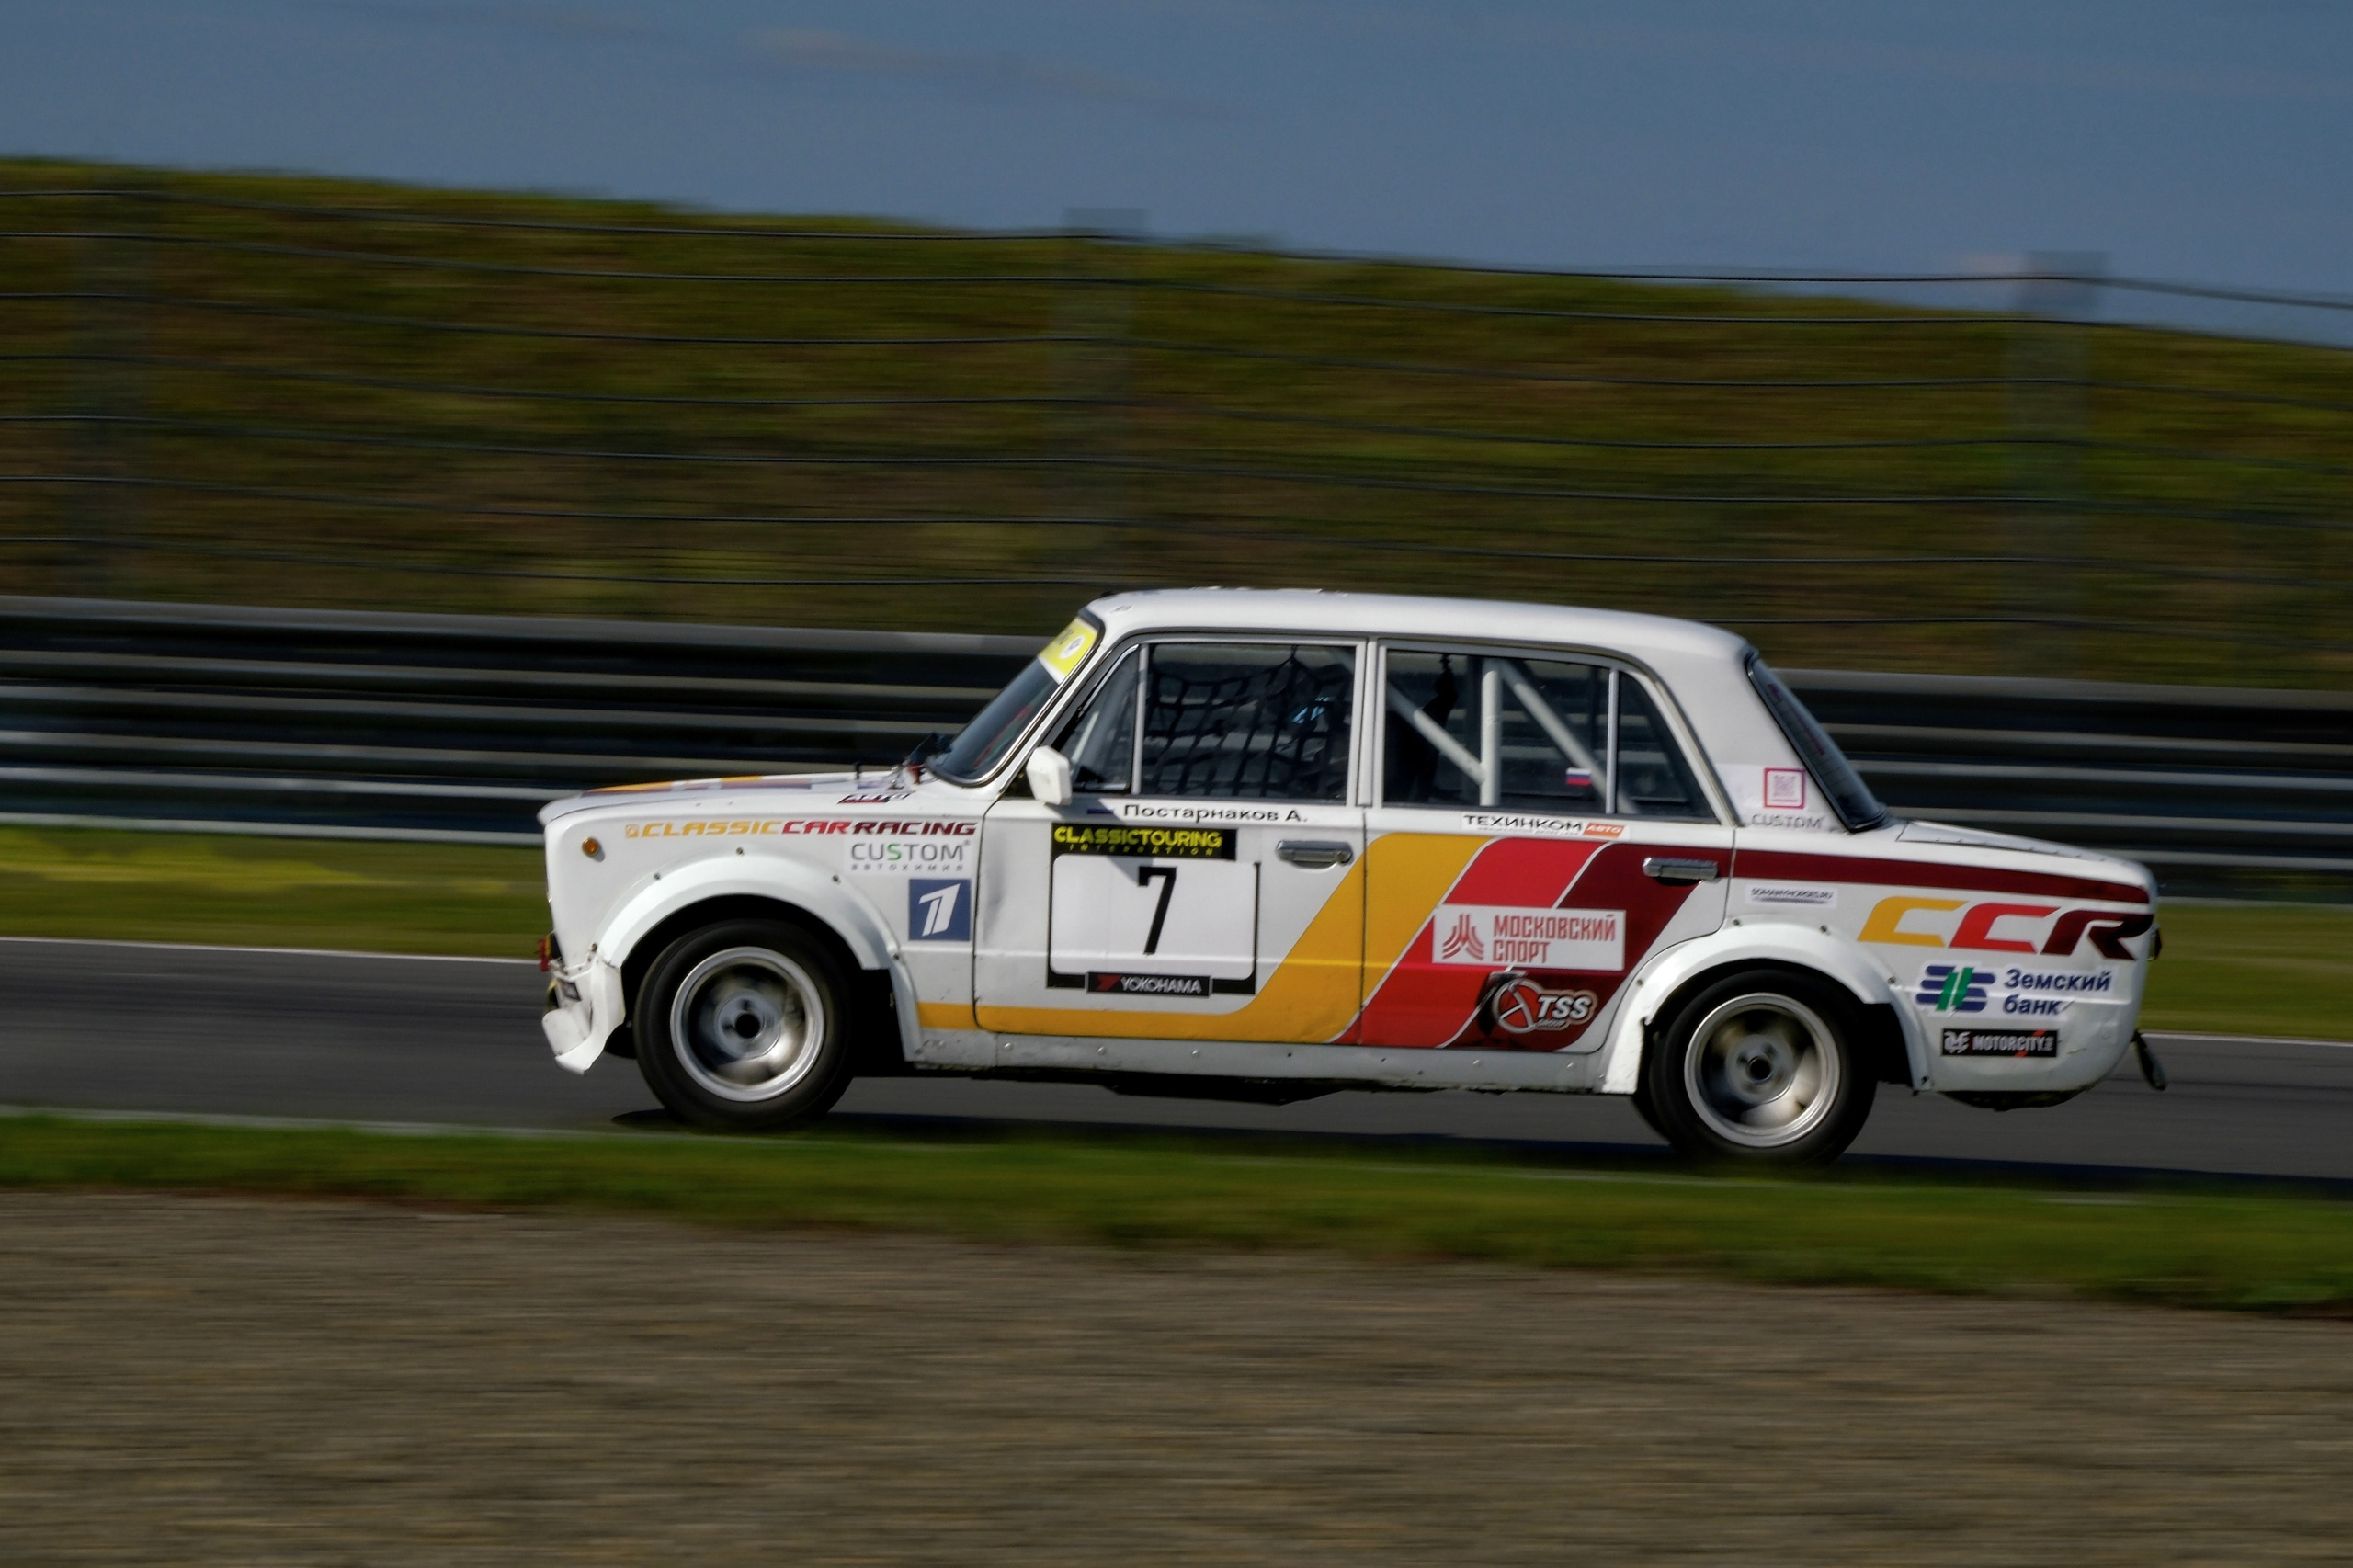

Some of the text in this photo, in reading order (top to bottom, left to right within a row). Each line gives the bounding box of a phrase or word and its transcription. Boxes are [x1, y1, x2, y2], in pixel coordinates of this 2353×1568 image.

[1124, 804, 1279, 824] Постарнаков
[1464, 814, 1583, 832] ТЕХИНКОМ
[1053, 825, 1223, 849] CLASSICTOURING
[850, 842, 964, 861] CUSTOM
[1138, 865, 1177, 956] 7
[1493, 914, 1616, 942] МОСКОВСКИЙ
[1857, 895, 2155, 961] CCR
[1492, 939, 1551, 964] СПОРТ
[1120, 975, 1203, 994] YOKOHAMA
[2004, 968, 2113, 993] Земский
[1537, 995, 1593, 1020] TSS
[2003, 994, 2065, 1016] банк
